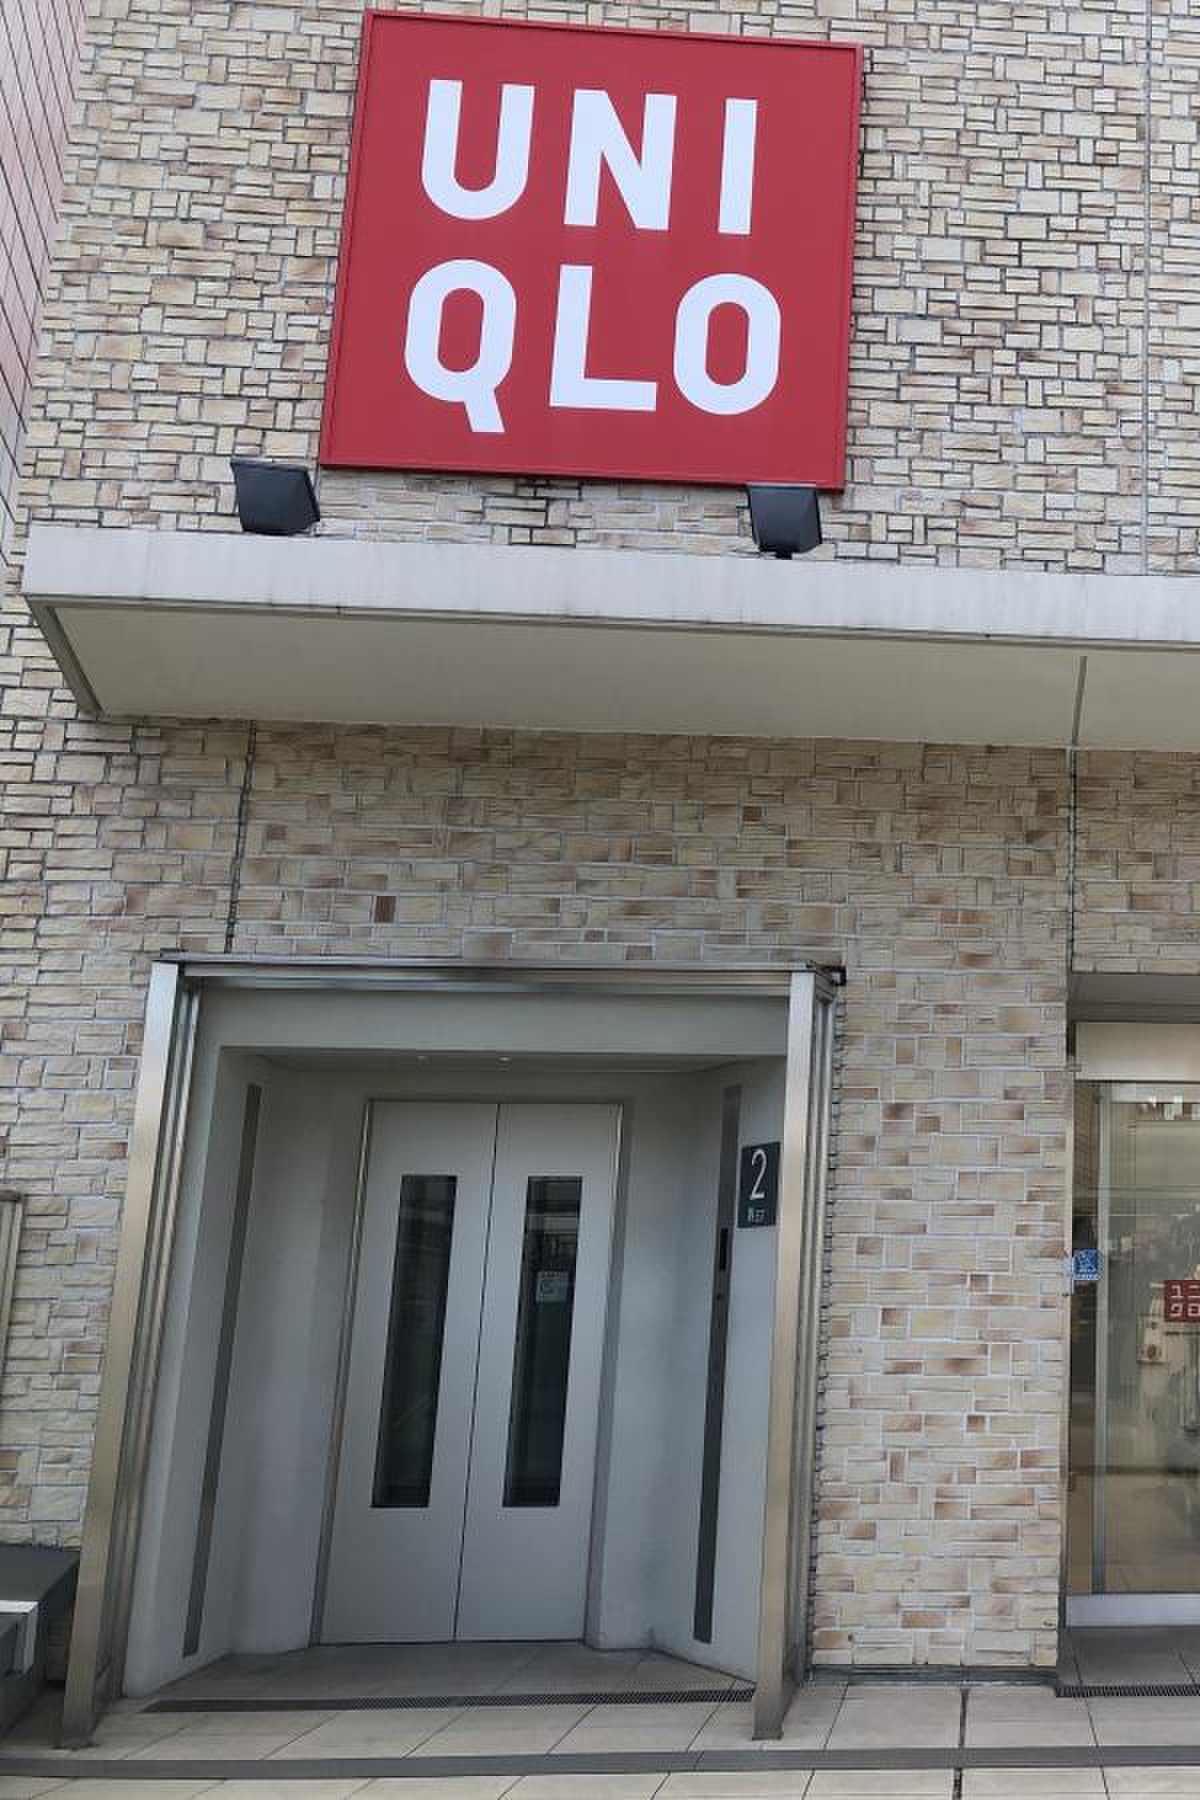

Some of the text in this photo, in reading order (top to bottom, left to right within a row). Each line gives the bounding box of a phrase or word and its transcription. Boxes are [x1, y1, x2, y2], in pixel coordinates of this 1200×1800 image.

[421, 79, 758, 235] UNI
[404, 259, 782, 433] QLO
[750, 1148, 768, 1201] 2
